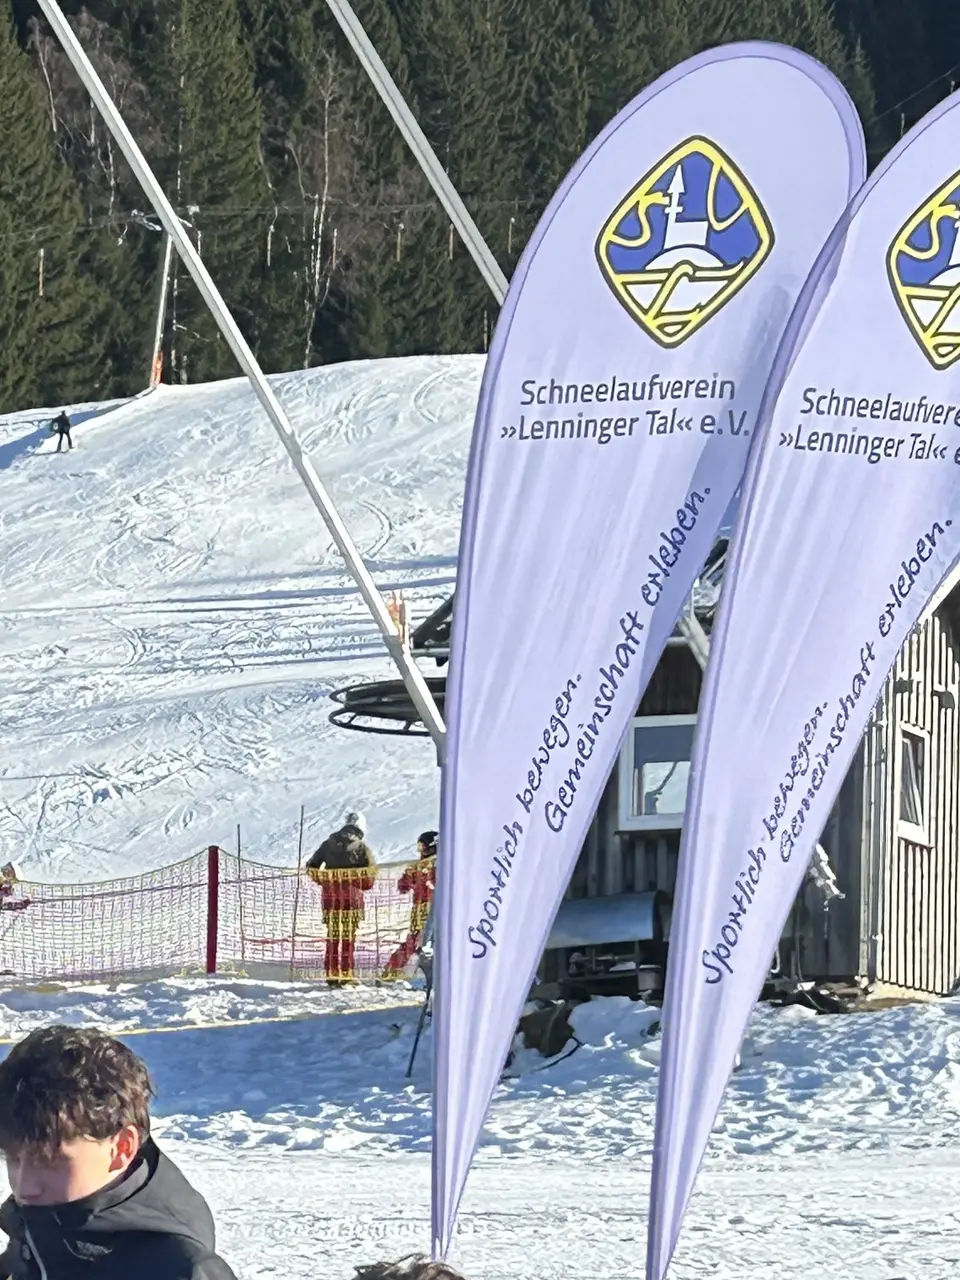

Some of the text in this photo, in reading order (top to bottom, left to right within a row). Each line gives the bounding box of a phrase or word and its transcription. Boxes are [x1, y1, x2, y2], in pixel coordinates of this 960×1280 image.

[520, 372, 735, 405] Schneelaufverein
[544, 486, 711, 833] Gemeinschaft erleben.
[780, 518, 953, 863] Gemeinschaft erleben.
[471, 673, 582, 960] Sportlich bewegen.
[701, 701, 829, 985] Sportlich bewegen.
